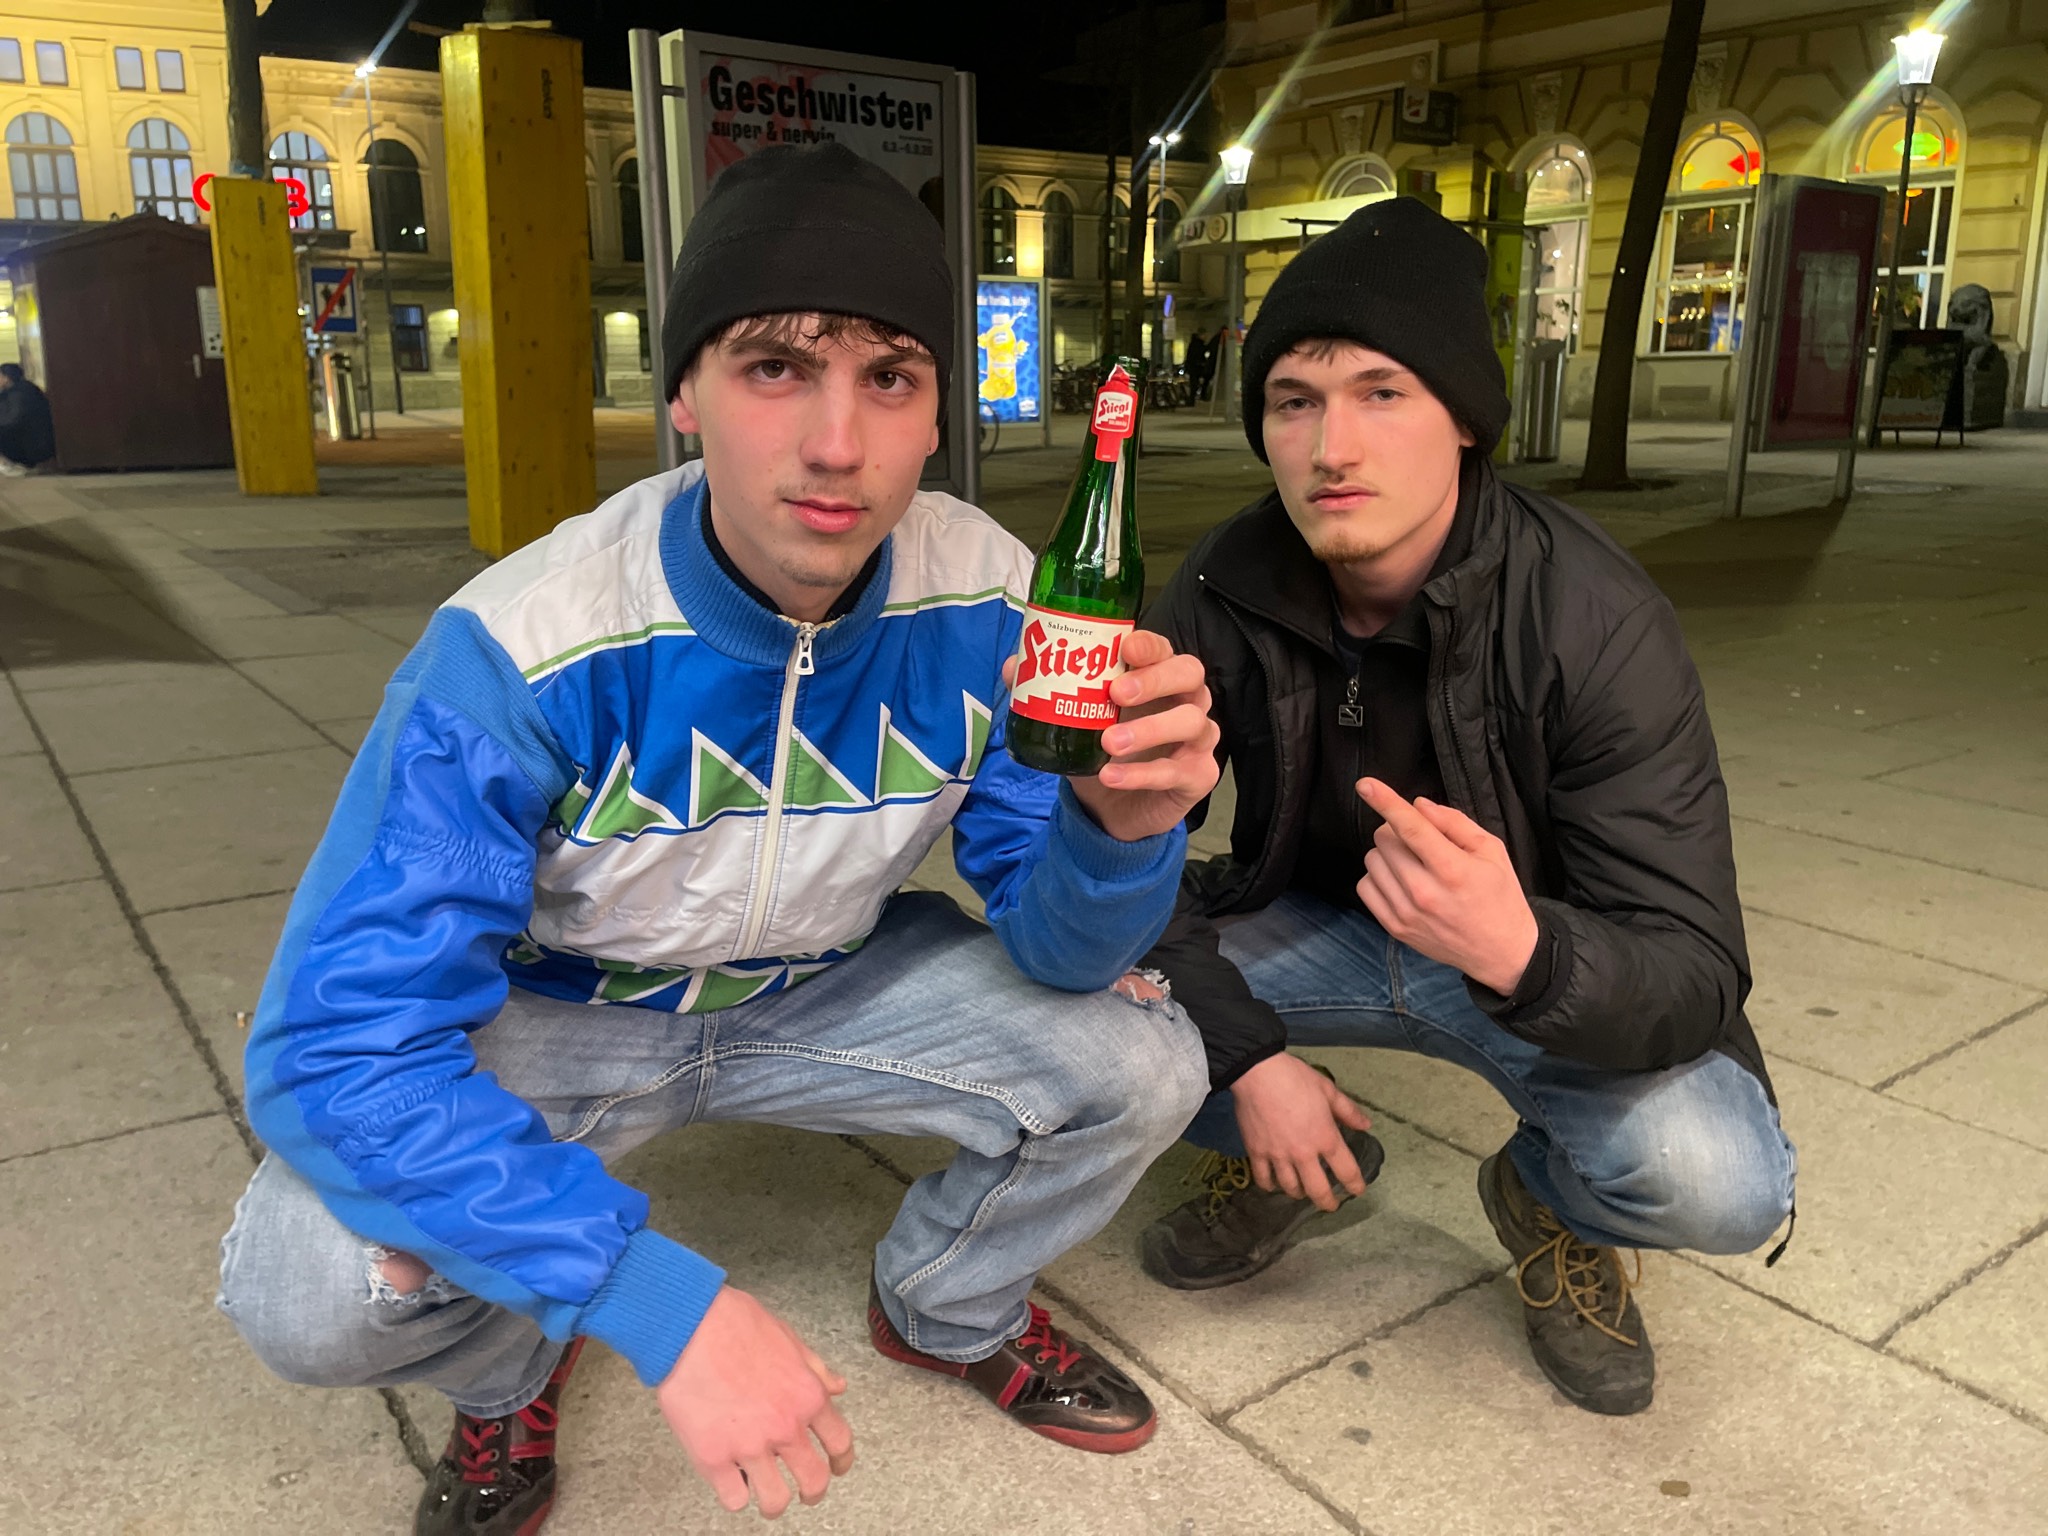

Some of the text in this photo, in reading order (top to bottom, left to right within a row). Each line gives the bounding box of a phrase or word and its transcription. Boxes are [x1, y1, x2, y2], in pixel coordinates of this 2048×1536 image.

[708, 65, 933, 131] Geschwister
[711, 120, 762, 142] super
[766, 121, 777, 141] &
[1098, 398, 1130, 418] Stiegl
[1047, 621, 1094, 637] Salzburger
[1015, 619, 1123, 688] Stiegl
